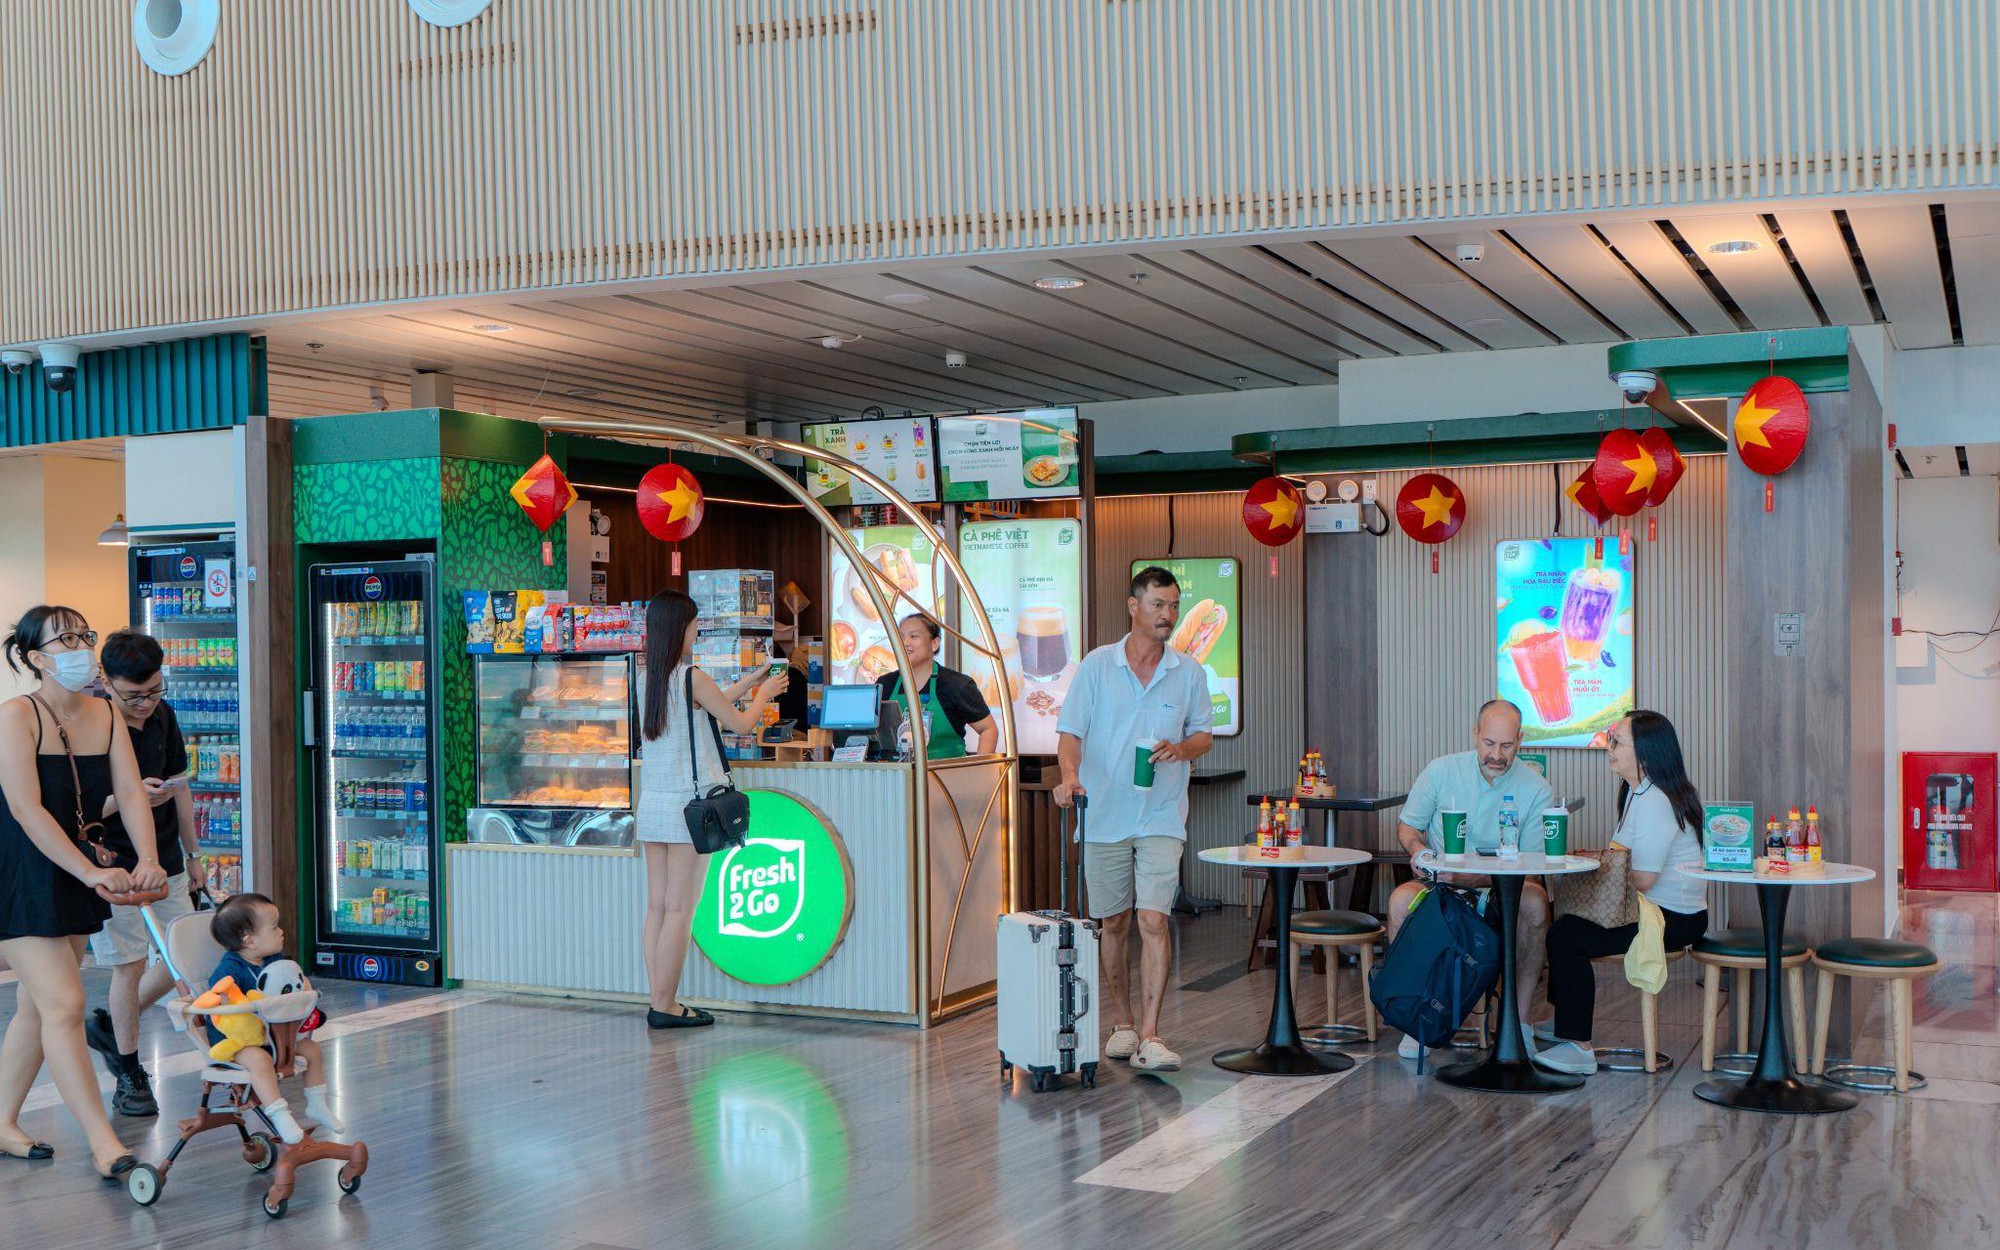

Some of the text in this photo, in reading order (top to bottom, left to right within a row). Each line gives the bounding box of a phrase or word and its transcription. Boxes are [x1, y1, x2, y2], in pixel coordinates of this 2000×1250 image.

[825, 436, 846, 445] XANH
[963, 527, 1029, 543] CÀ PHÊ VIỆT
[963, 542, 1029, 551] VIETNAMESE COFFEE
[730, 856, 796, 892] Fresh
[730, 889, 780, 920] 2Go
